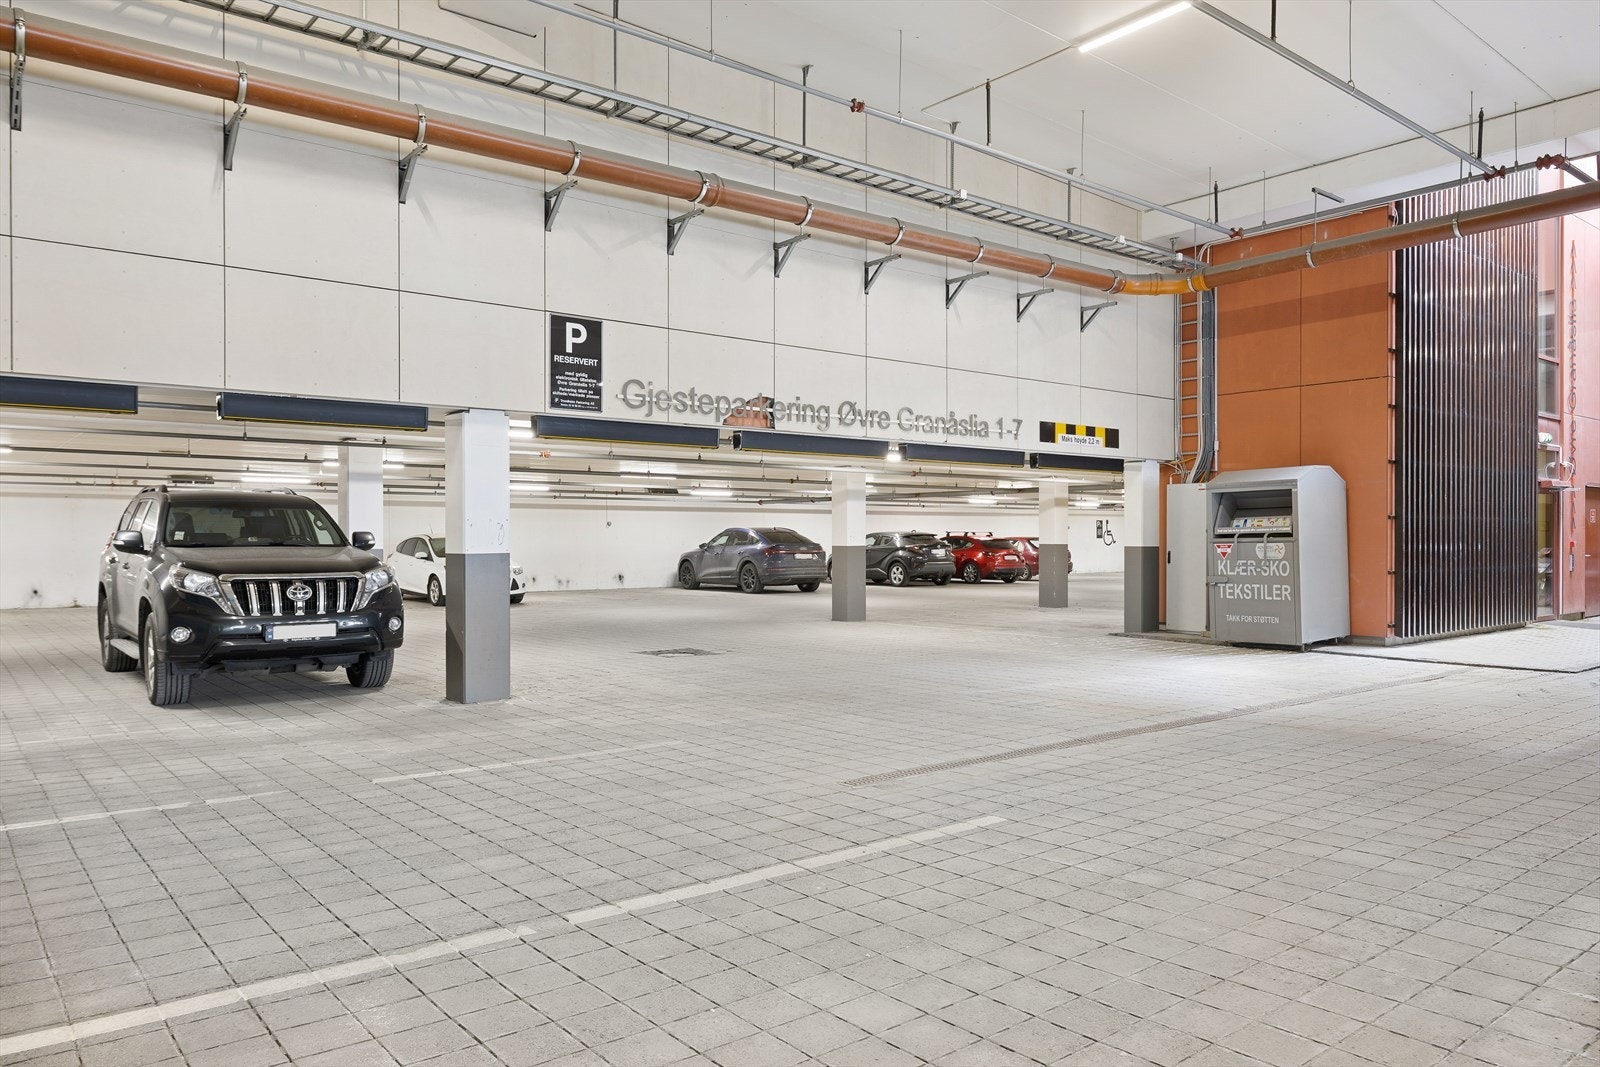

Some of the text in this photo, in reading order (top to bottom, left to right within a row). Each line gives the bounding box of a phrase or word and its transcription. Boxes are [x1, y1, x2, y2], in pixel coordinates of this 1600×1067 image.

[565, 322, 587, 353] P
[554, 355, 599, 367] RESERVERT
[621, 379, 1023, 441] Gjesteparkering Øvre Granåslia 1-7
[1061, 435, 1073, 443] Maks
[1218, 560, 1290, 577] KLÆR-SKO
[1218, 584, 1291, 600] TEKSTILER
[1253, 616, 1279, 624] STØTTEN
